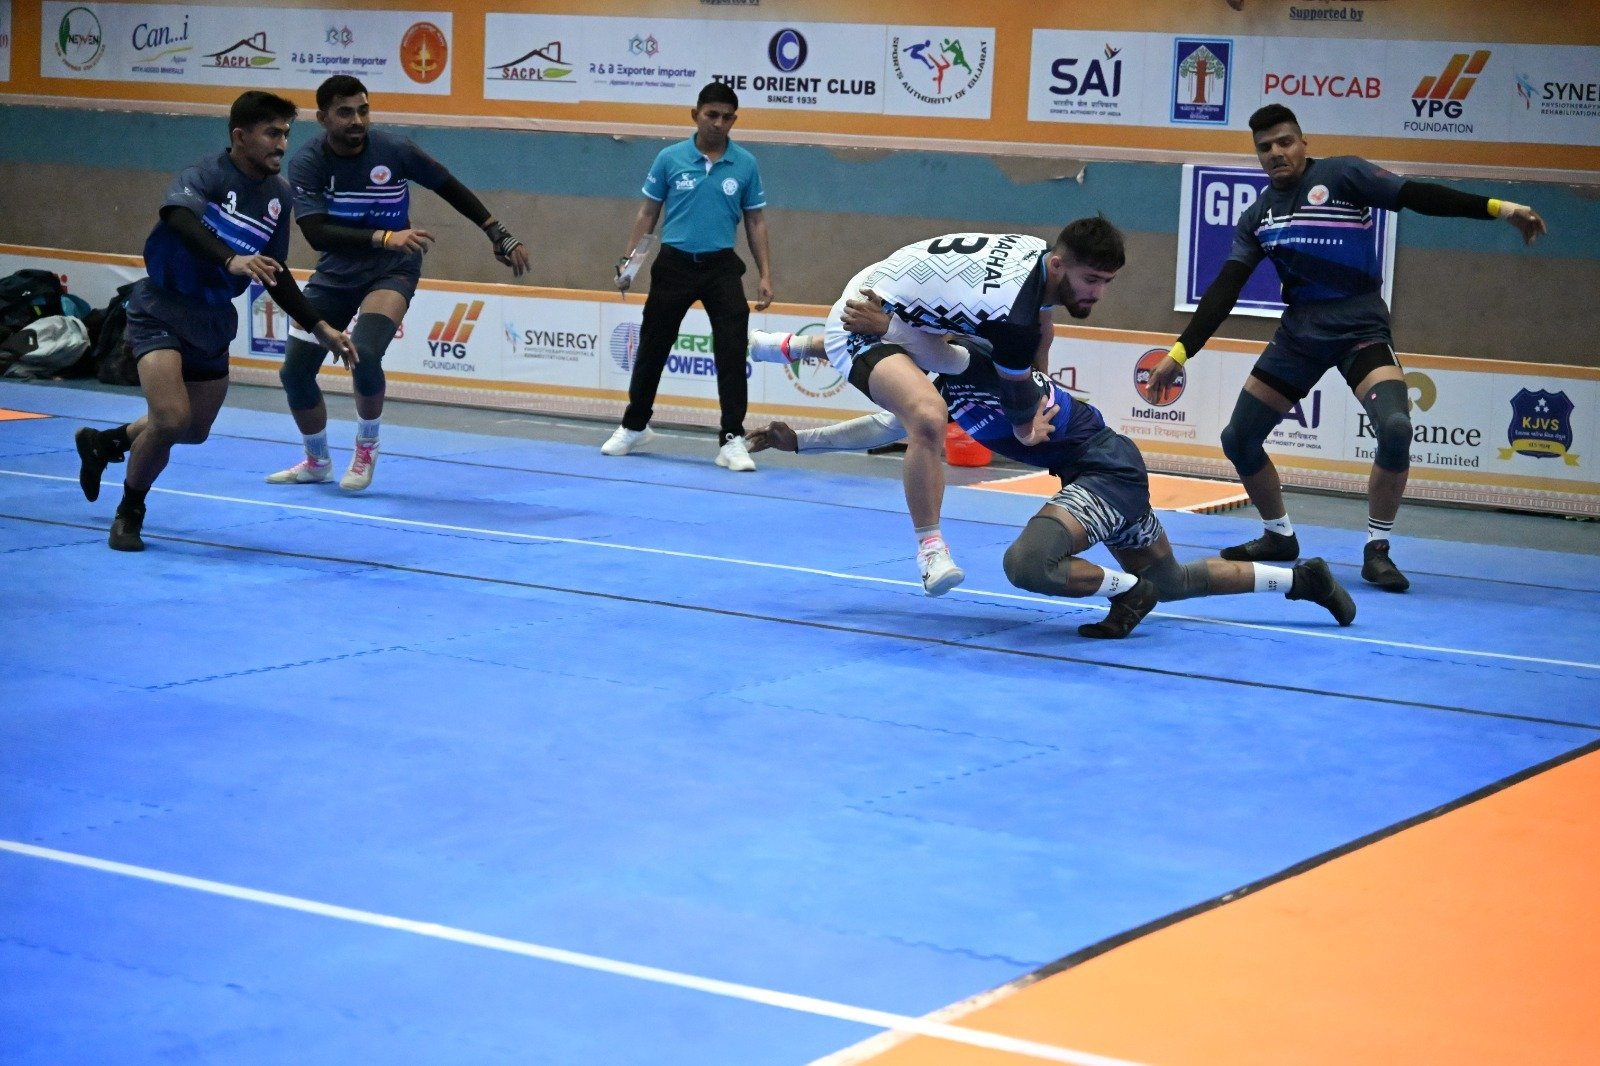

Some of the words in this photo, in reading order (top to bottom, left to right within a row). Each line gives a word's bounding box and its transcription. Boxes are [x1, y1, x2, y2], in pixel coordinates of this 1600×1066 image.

[1289, 6, 1347, 20] Supported
[1350, 7, 1364, 21] by
[215, 55, 250, 67] SACPL
[317, 54, 350, 66] Exporter
[352, 56, 387, 67] importer
[502, 67, 543, 80] SACPL
[589, 63, 595, 73] R
[617, 64, 655, 77] Exporter
[658, 66, 696, 78] importer
[892, 36, 904, 80] SPORTS
[902, 81, 953, 104] AUTHORITY
[954, 89, 967, 100] OF
[967, 41, 987, 90] GUJARAT
[1049, 57, 1122, 98] SAI
[753, 75, 821, 93] ORIENT
[827, 79, 876, 95] CLUB
[1264, 73, 1381, 98] POLYCAB
[767, 95, 794, 104] SINCE
[796, 96, 817, 105] 1935
[1411, 99, 1463, 119] YPG
[1403, 121, 1474, 134] FOUNDATION
[927, 236, 990, 255] 3
[525, 330, 598, 349] SYNERGY
[428, 341, 466, 360] YPG
[423, 360, 475, 372] FOUNDATION
[1132, 406, 1186, 422] IndianOil
[1279, 390, 1321, 429] AI
[1522, 416, 1560, 431] KJVS
[1264, 439, 1296, 447] AUTHORITY
[1427, 452, 1479, 468] Limited
